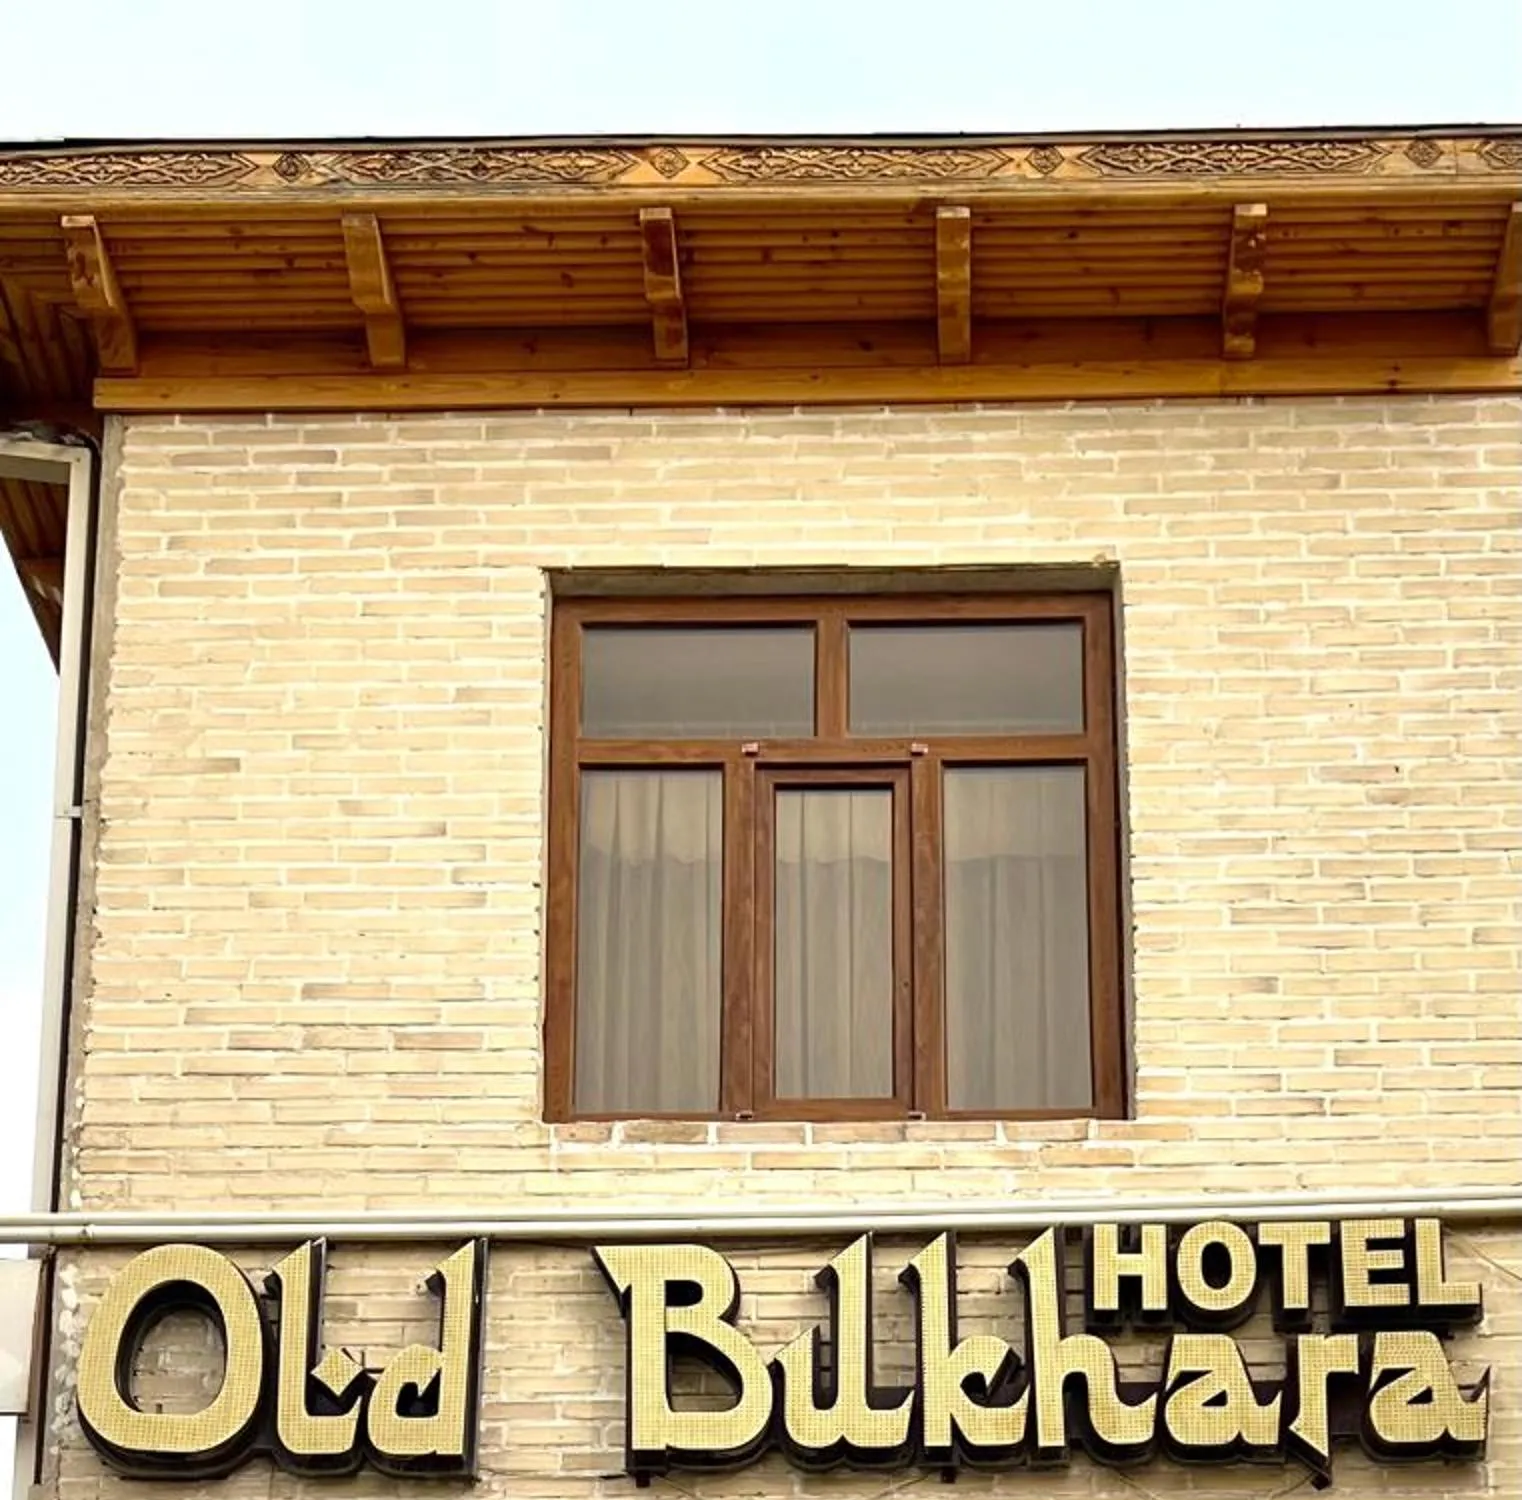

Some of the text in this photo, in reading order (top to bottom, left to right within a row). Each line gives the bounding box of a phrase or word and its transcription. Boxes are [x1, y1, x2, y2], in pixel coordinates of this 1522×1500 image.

[77, 1227, 1489, 1459] Old Bukhara
[1091, 1218, 1481, 1312] HOTEL
